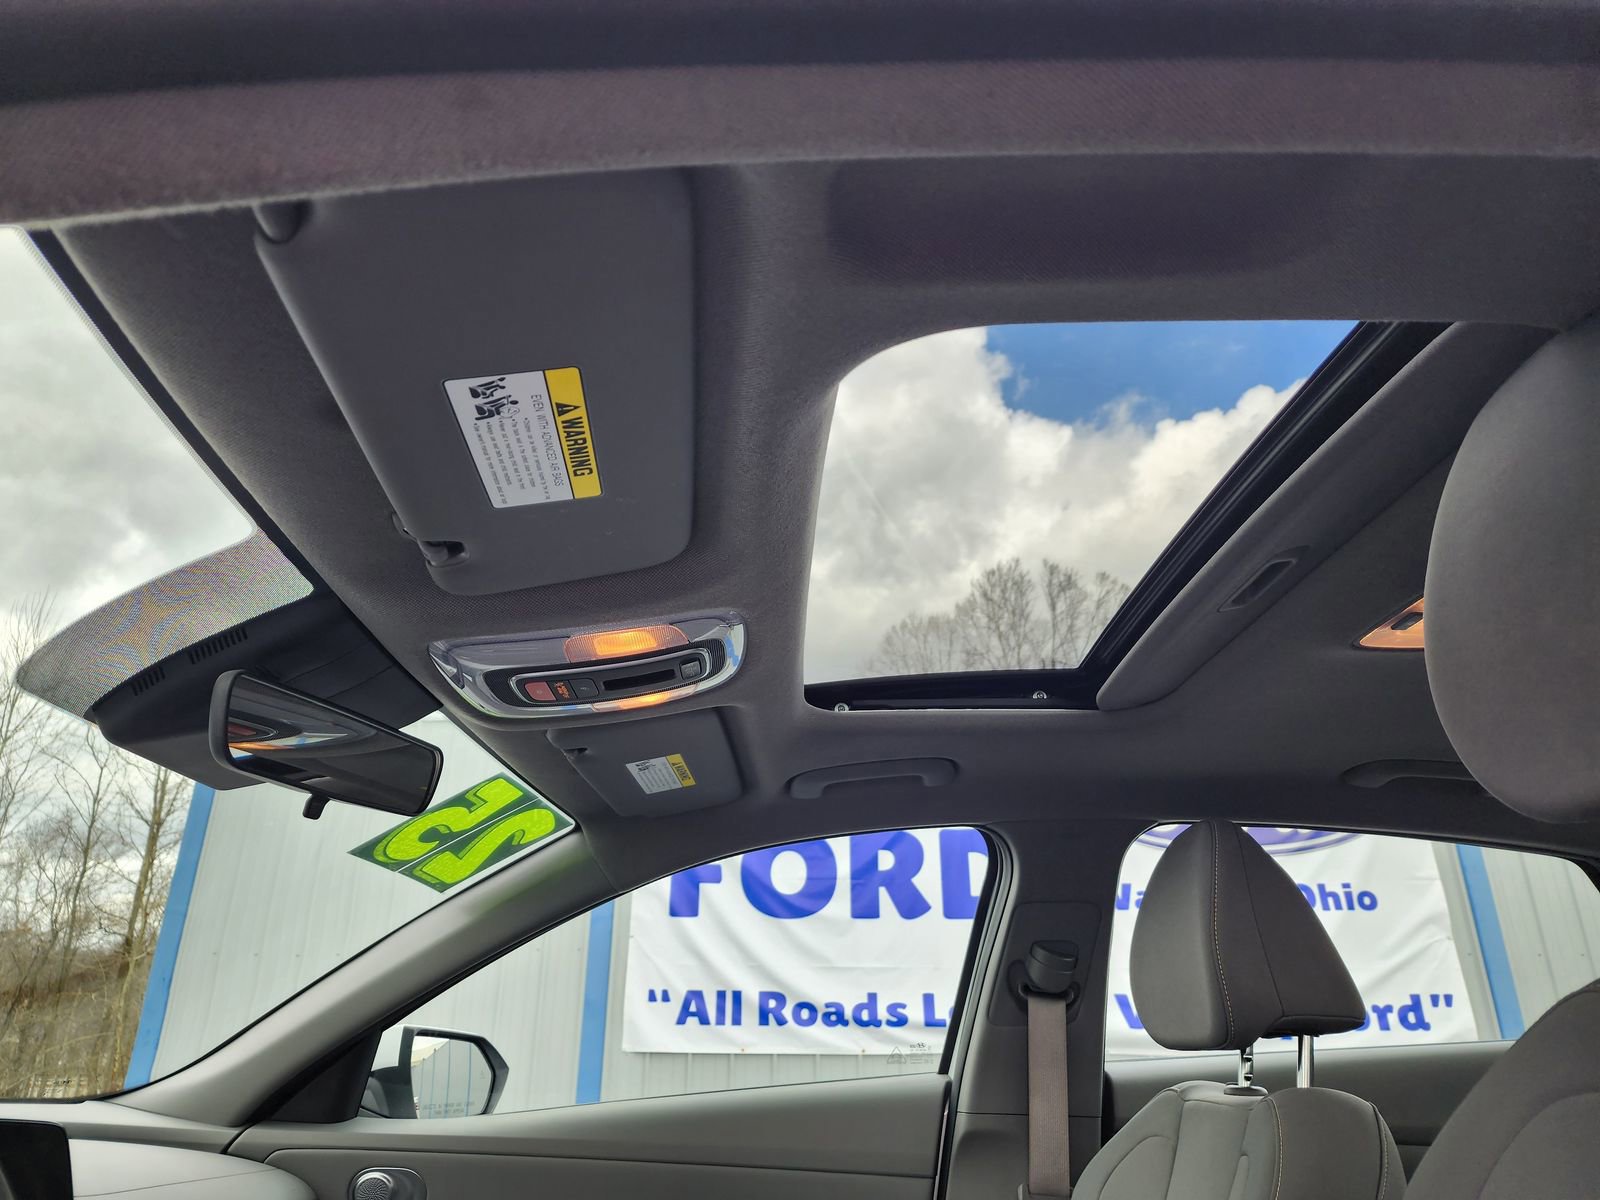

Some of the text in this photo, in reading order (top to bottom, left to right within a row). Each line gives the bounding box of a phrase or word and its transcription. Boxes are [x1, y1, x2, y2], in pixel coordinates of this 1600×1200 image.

[530, 394, 545, 412] EVEN
[536, 413, 549, 430] WITH
[541, 430, 558, 461] ADVANCED
[561, 416, 594, 478] WARNING
[550, 461, 561, 472] AIR
[551, 471, 565, 487] BAGS
[758, 990, 909, 1028] Roads
